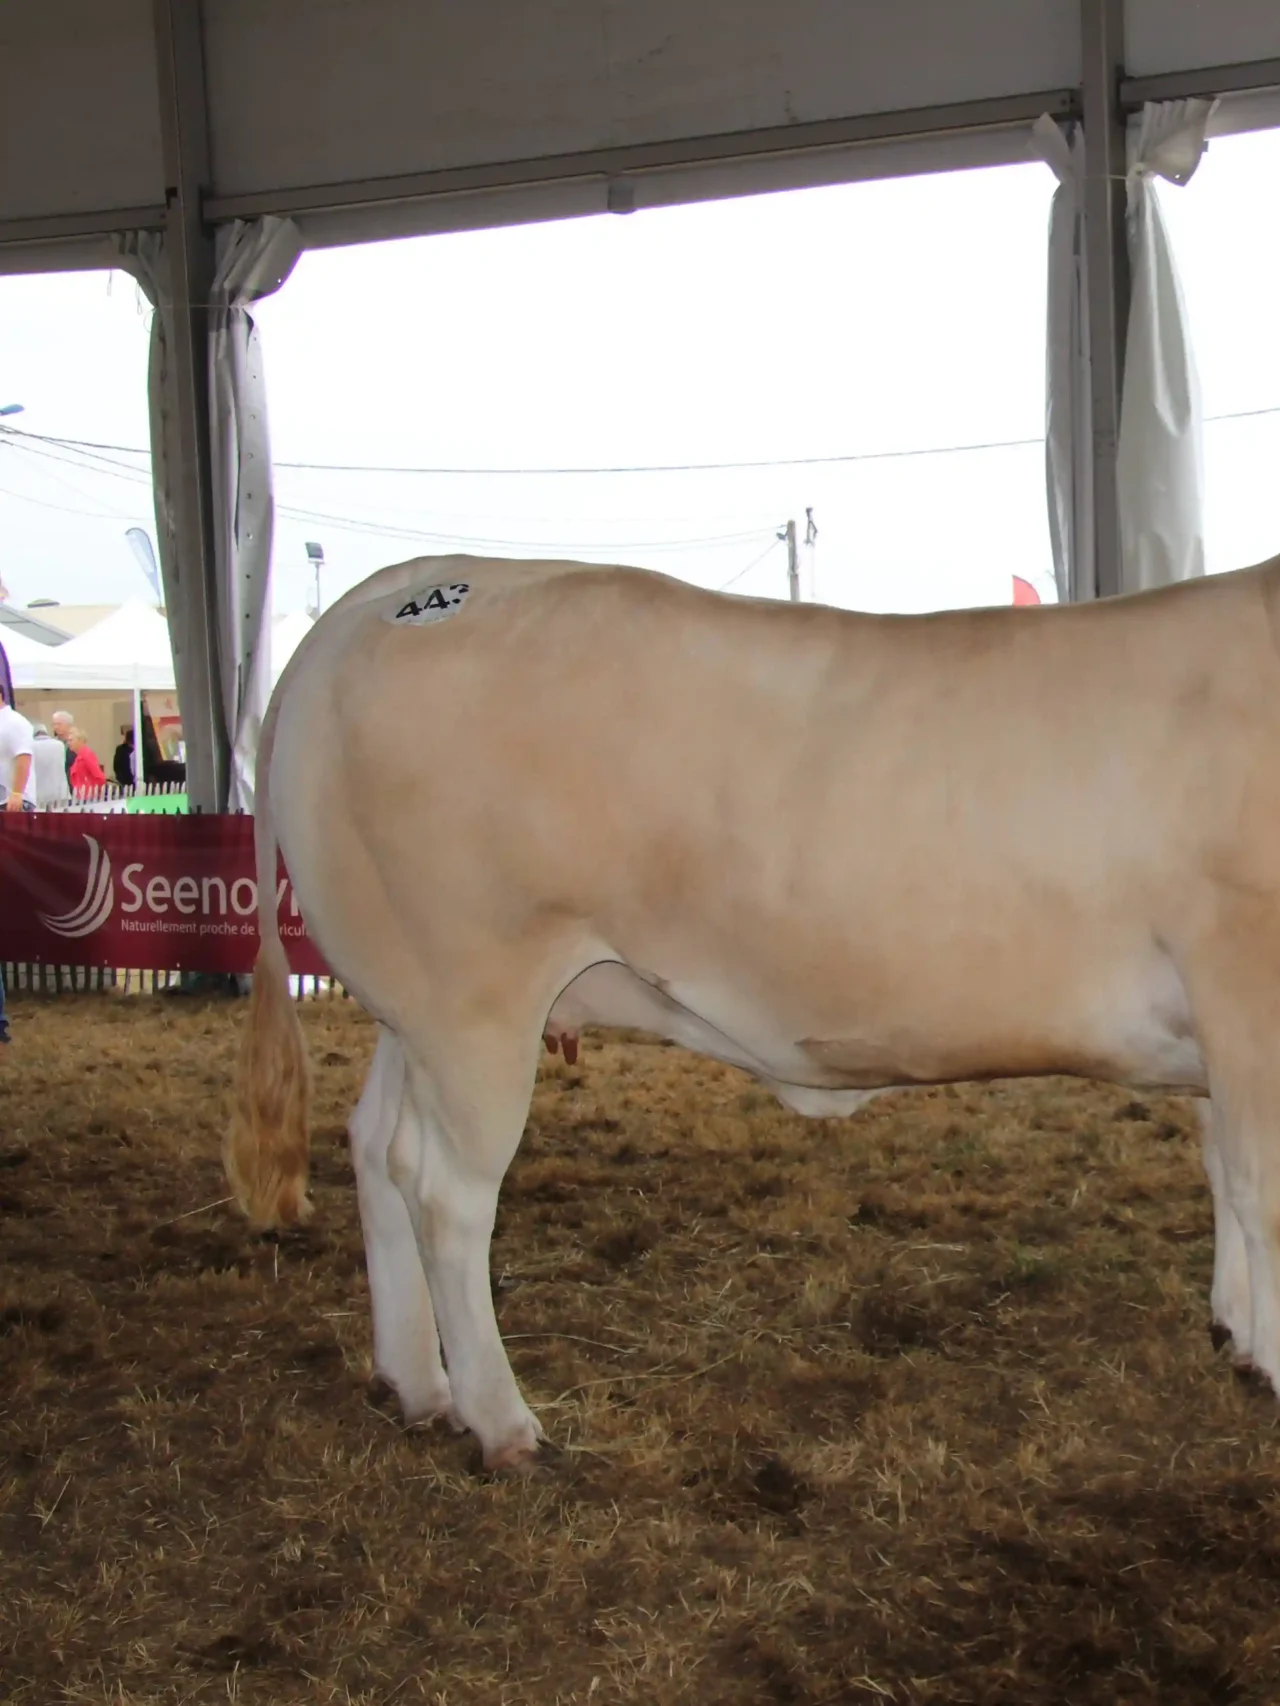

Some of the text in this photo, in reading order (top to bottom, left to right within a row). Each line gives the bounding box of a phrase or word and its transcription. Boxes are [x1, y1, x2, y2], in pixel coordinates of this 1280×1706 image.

[121, 919, 196, 933] Naturellement
[199, 921, 237, 936] proche
[240, 922, 255, 935] de
